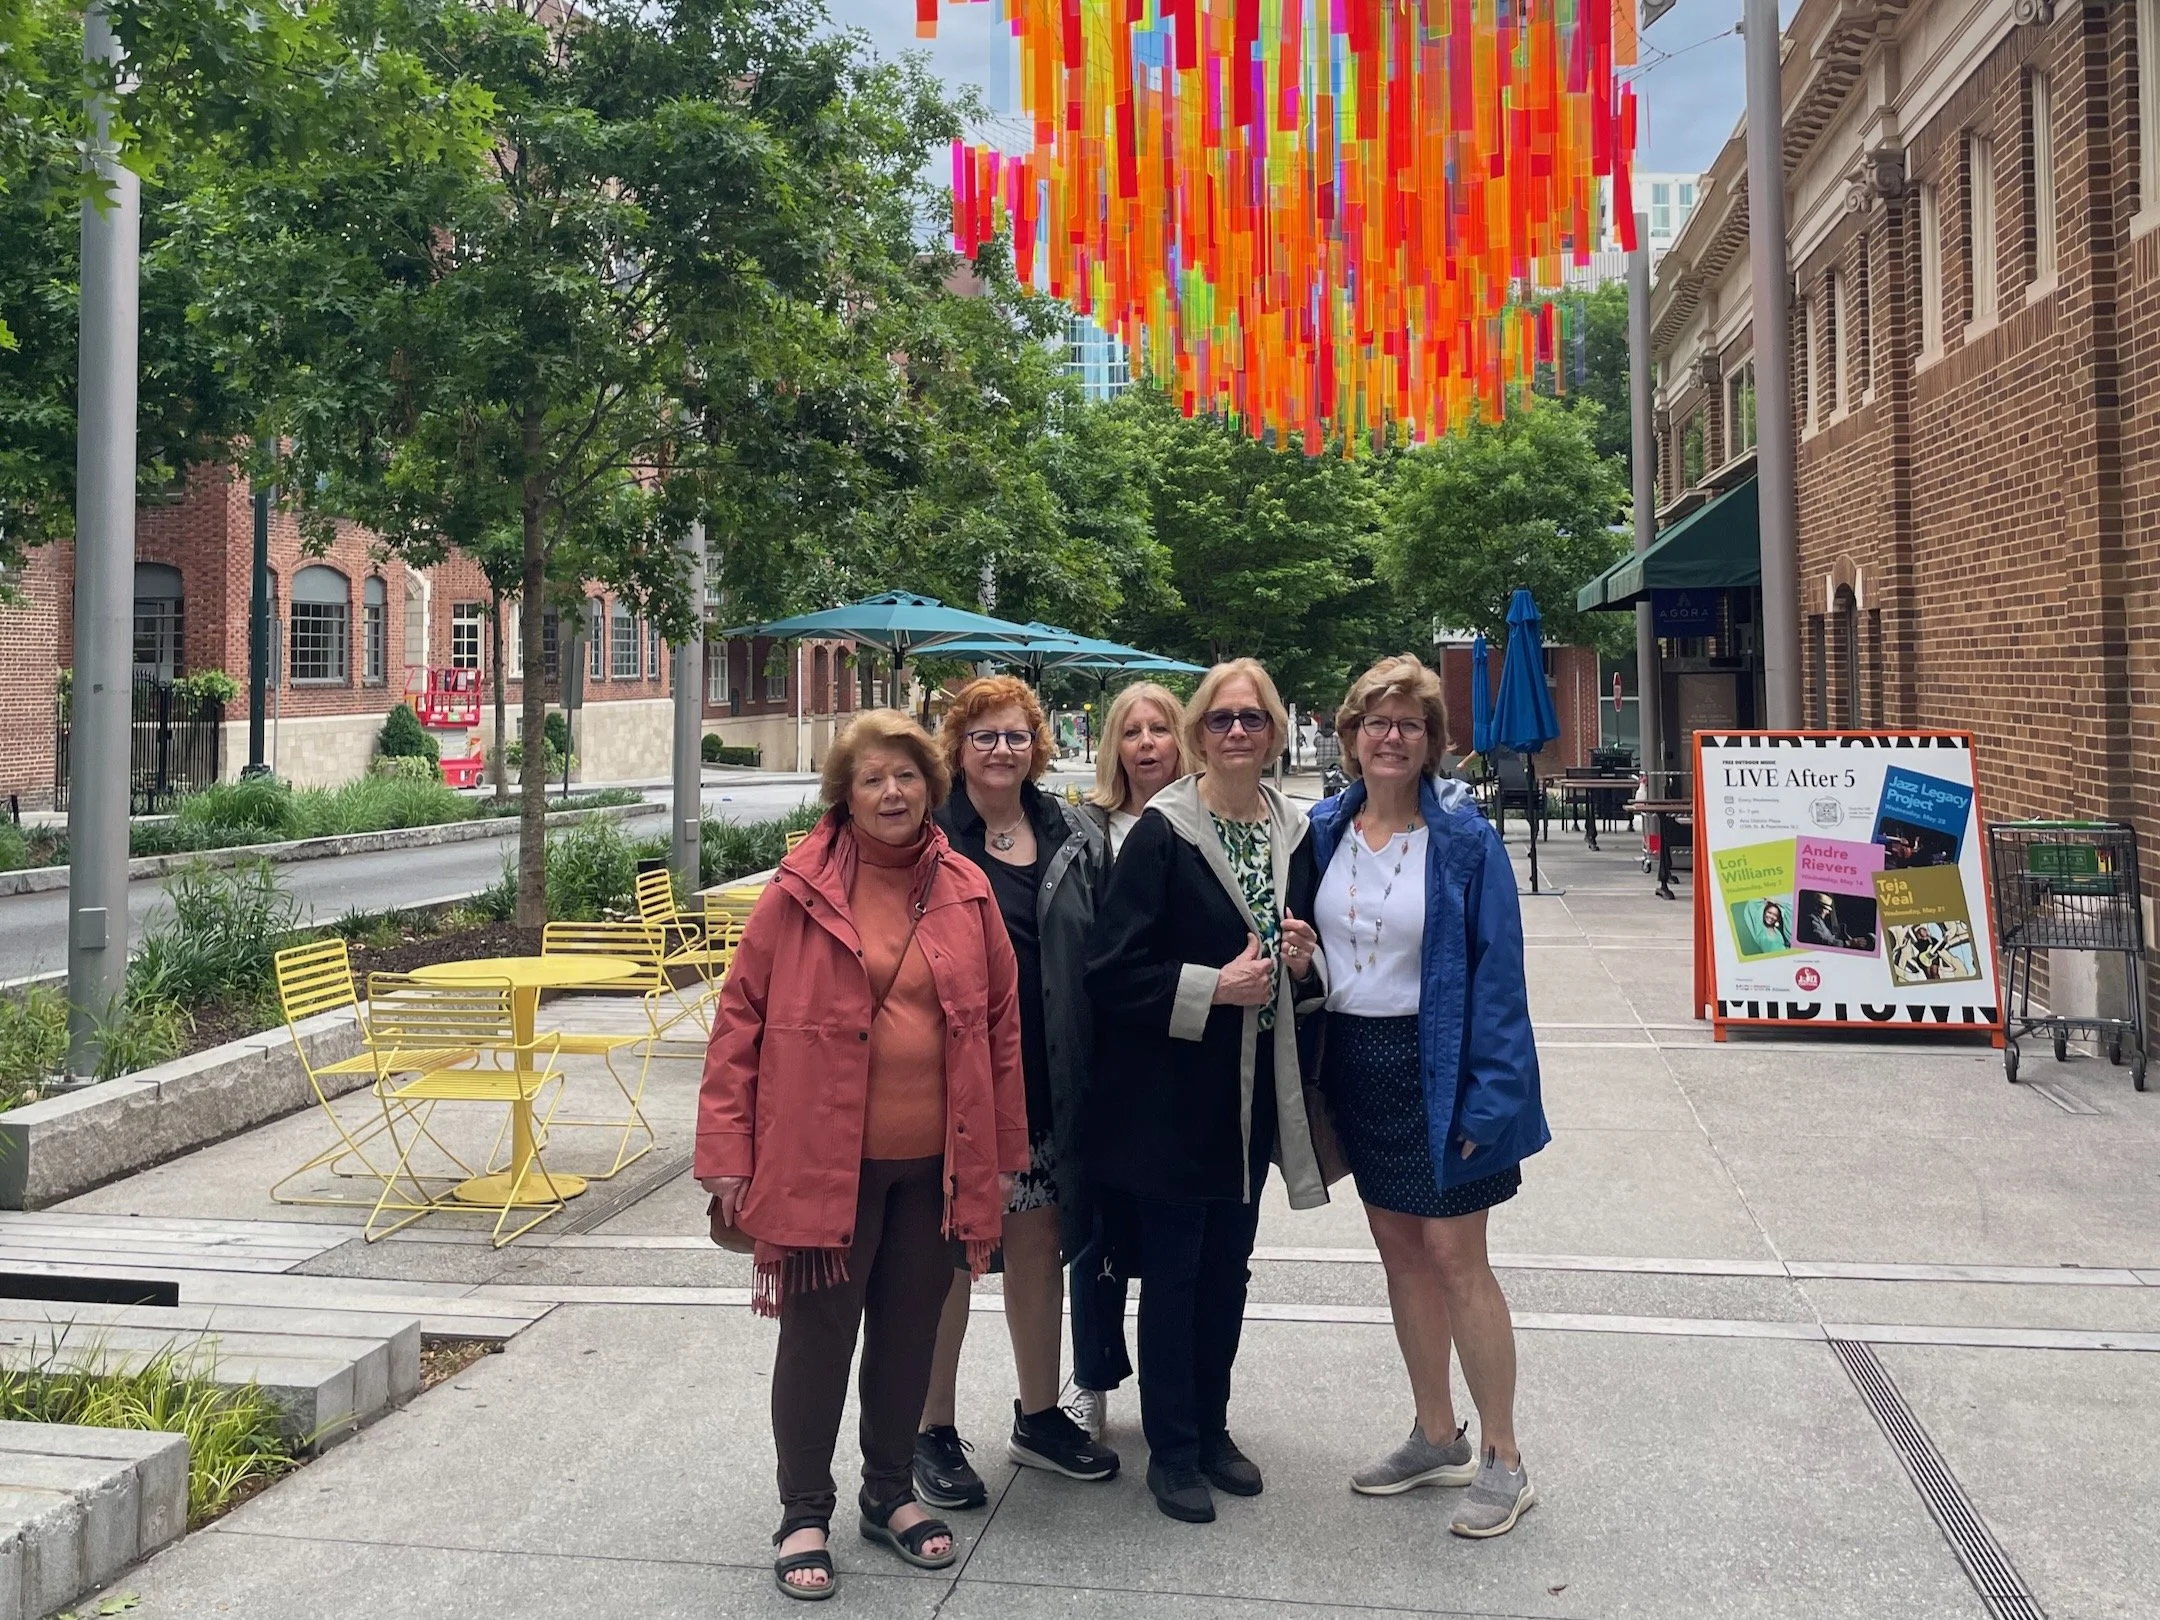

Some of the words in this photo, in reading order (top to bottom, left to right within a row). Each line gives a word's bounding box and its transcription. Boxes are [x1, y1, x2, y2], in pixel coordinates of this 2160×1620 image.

[1660, 608, 1709, 618] AGORA
[1724, 768, 1779, 787] LIVE
[1785, 768, 1838, 788] After
[1844, 769, 1855, 788] 5
[1886, 788, 1934, 811] Project
[1889, 776, 1919, 793] Jazz
[1921, 783, 1968, 808] Legacy
[1922, 813, 1937, 823] May
[1802, 844, 1848, 860] Andre
[1719, 855, 1747, 870] Lori
[1802, 858, 1857, 875] Rievers
[1721, 865, 1784, 884] Williams
[1876, 879, 1908, 894] Teja
[1880, 891, 1914, 906] Veal
[1922, 906, 1936, 915] May
